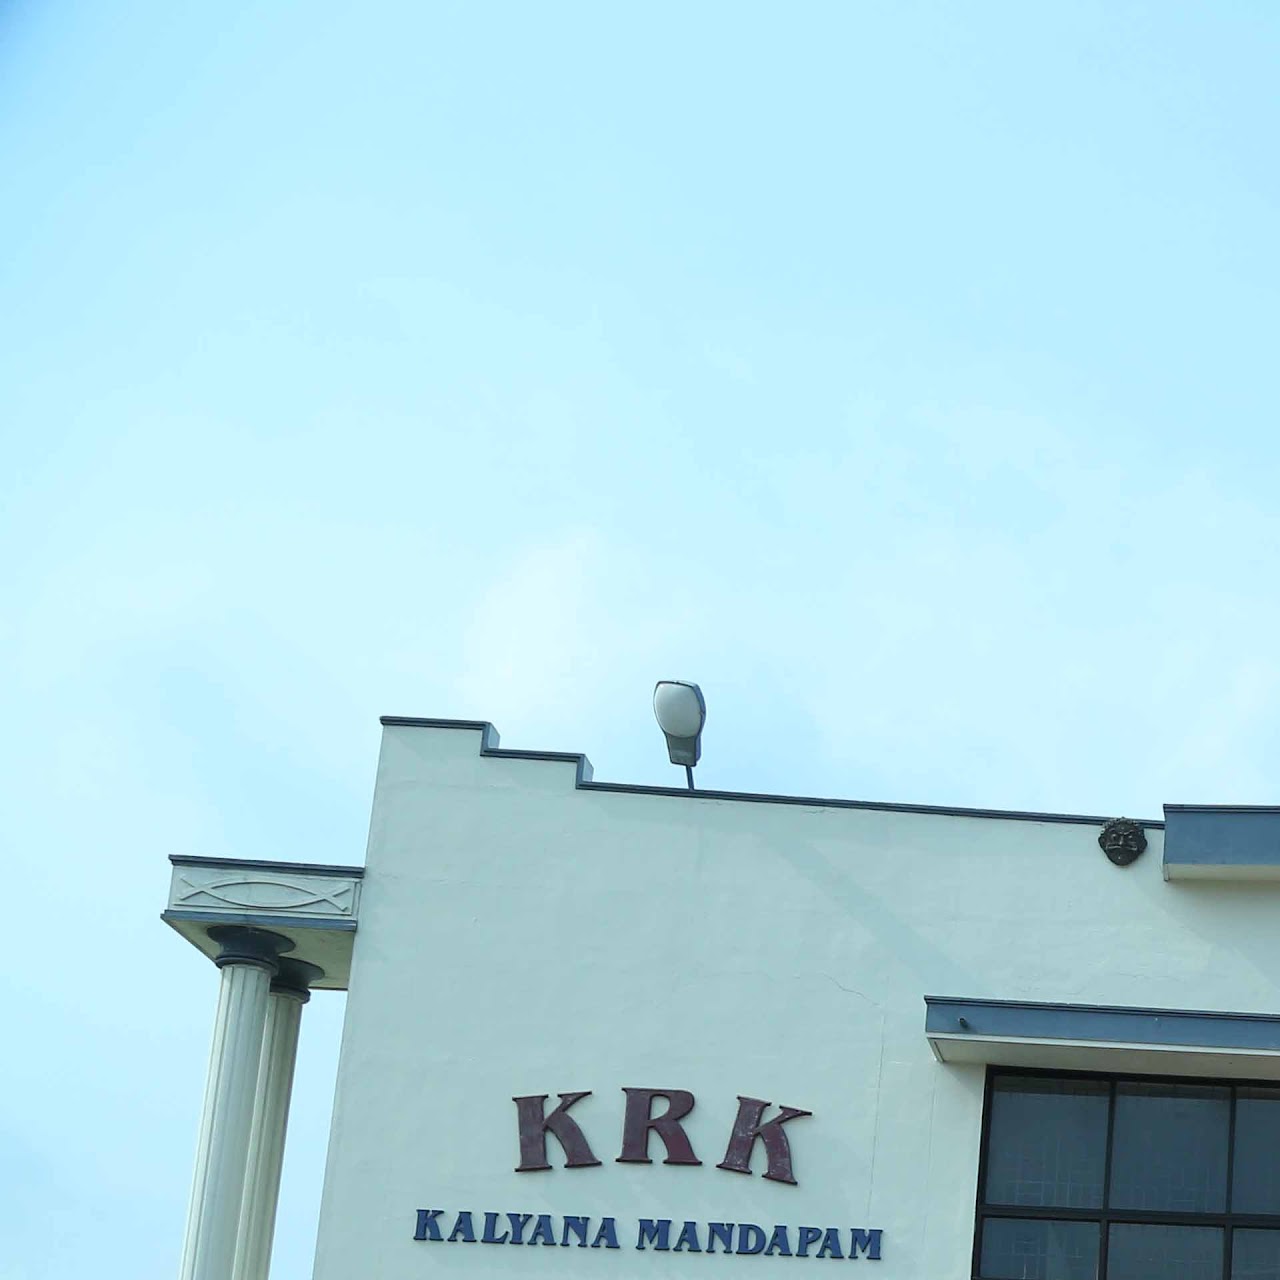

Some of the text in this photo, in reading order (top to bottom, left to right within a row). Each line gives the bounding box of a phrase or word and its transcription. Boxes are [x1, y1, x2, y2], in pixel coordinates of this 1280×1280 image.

[512, 1087, 813, 1185] KRK
[413, 1209, 883, 1260] KALYANA MANDAPAM
